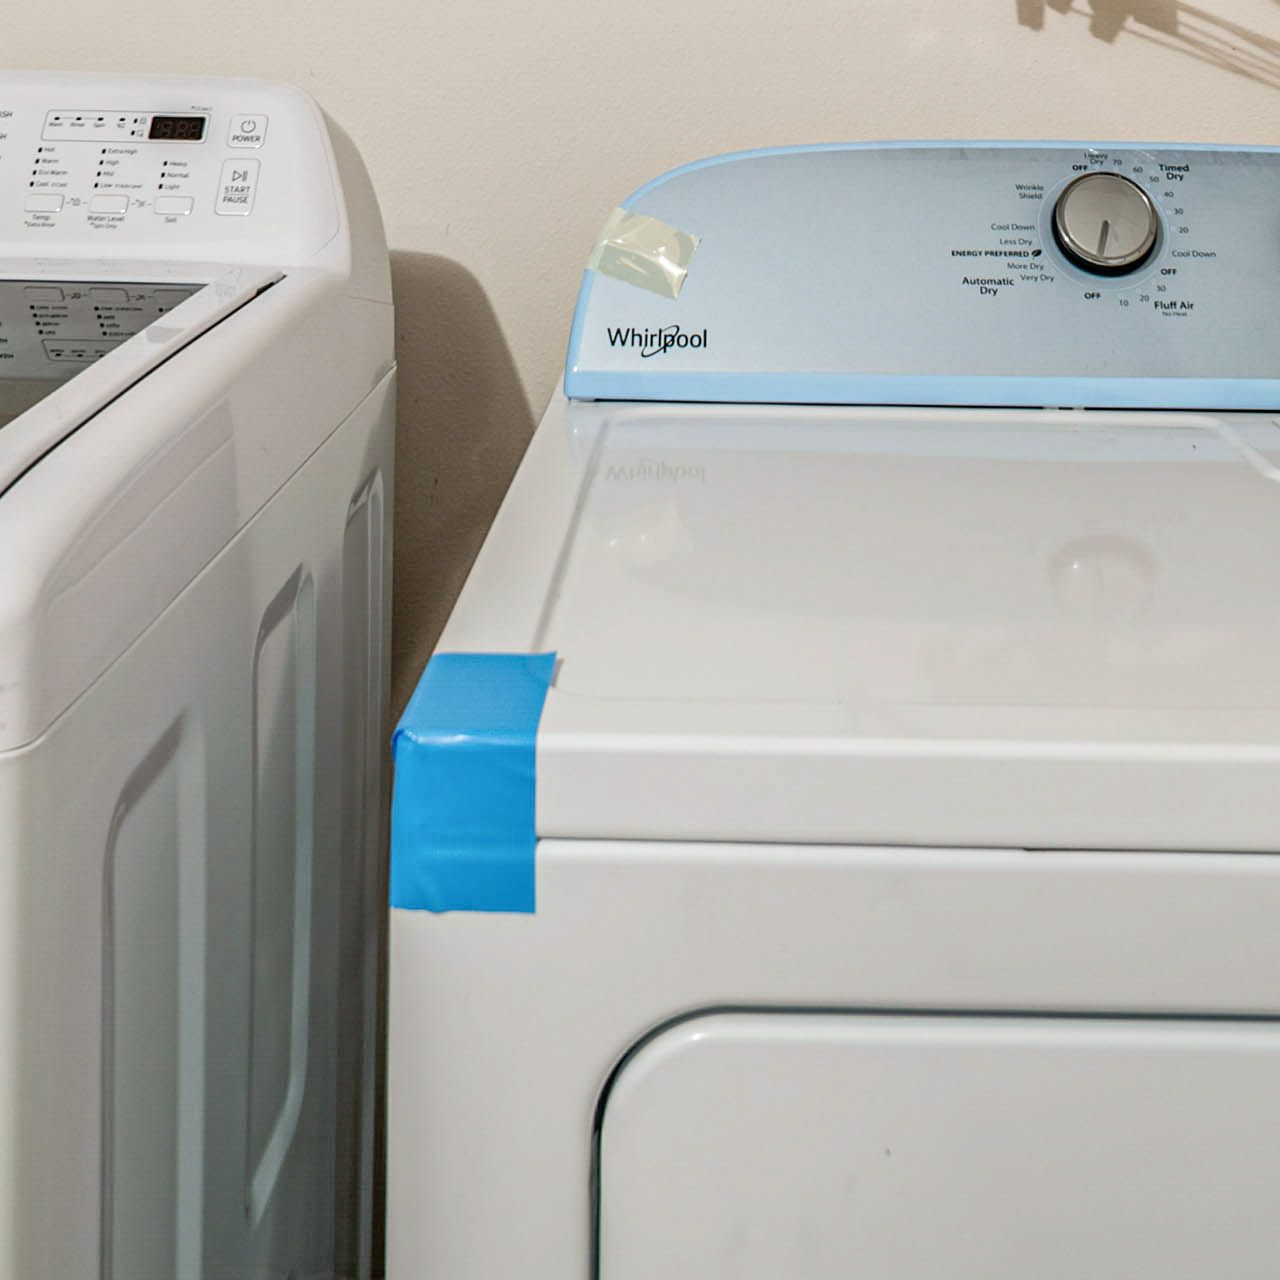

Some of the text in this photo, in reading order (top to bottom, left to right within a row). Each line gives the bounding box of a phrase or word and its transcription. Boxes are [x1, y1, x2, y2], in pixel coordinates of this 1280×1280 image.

[232, 135, 261, 143] POWER
[1158, 164, 1190, 172] Timed
[1166, 173, 1185, 182] Dry
[224, 185, 251, 194] START
[1015, 183, 1045, 192] Wrinkle
[222, 195, 248, 204] PAUSE
[1018, 192, 1043, 200] Shield
[990, 223, 1036, 231] Cool Down
[1178, 226, 1189, 234] 20
[999, 238, 1033, 247] Less Dry
[984, 250, 1030, 258] PREFERRED
[1171, 250, 1217, 258] Cool Down
[1007, 262, 1045, 272] More Dry
[962, 276, 1015, 286] Automatic
[1019, 274, 1055, 283] Very Dry
[979, 286, 999, 297] Dry
[1084, 292, 1102, 300] OFF
[1139, 294, 1150, 302] 20
[1119, 299, 1129, 307] 10
[1153, 300, 1194, 310] Fluff Air
[607, 325, 708, 357] Whirlpool
